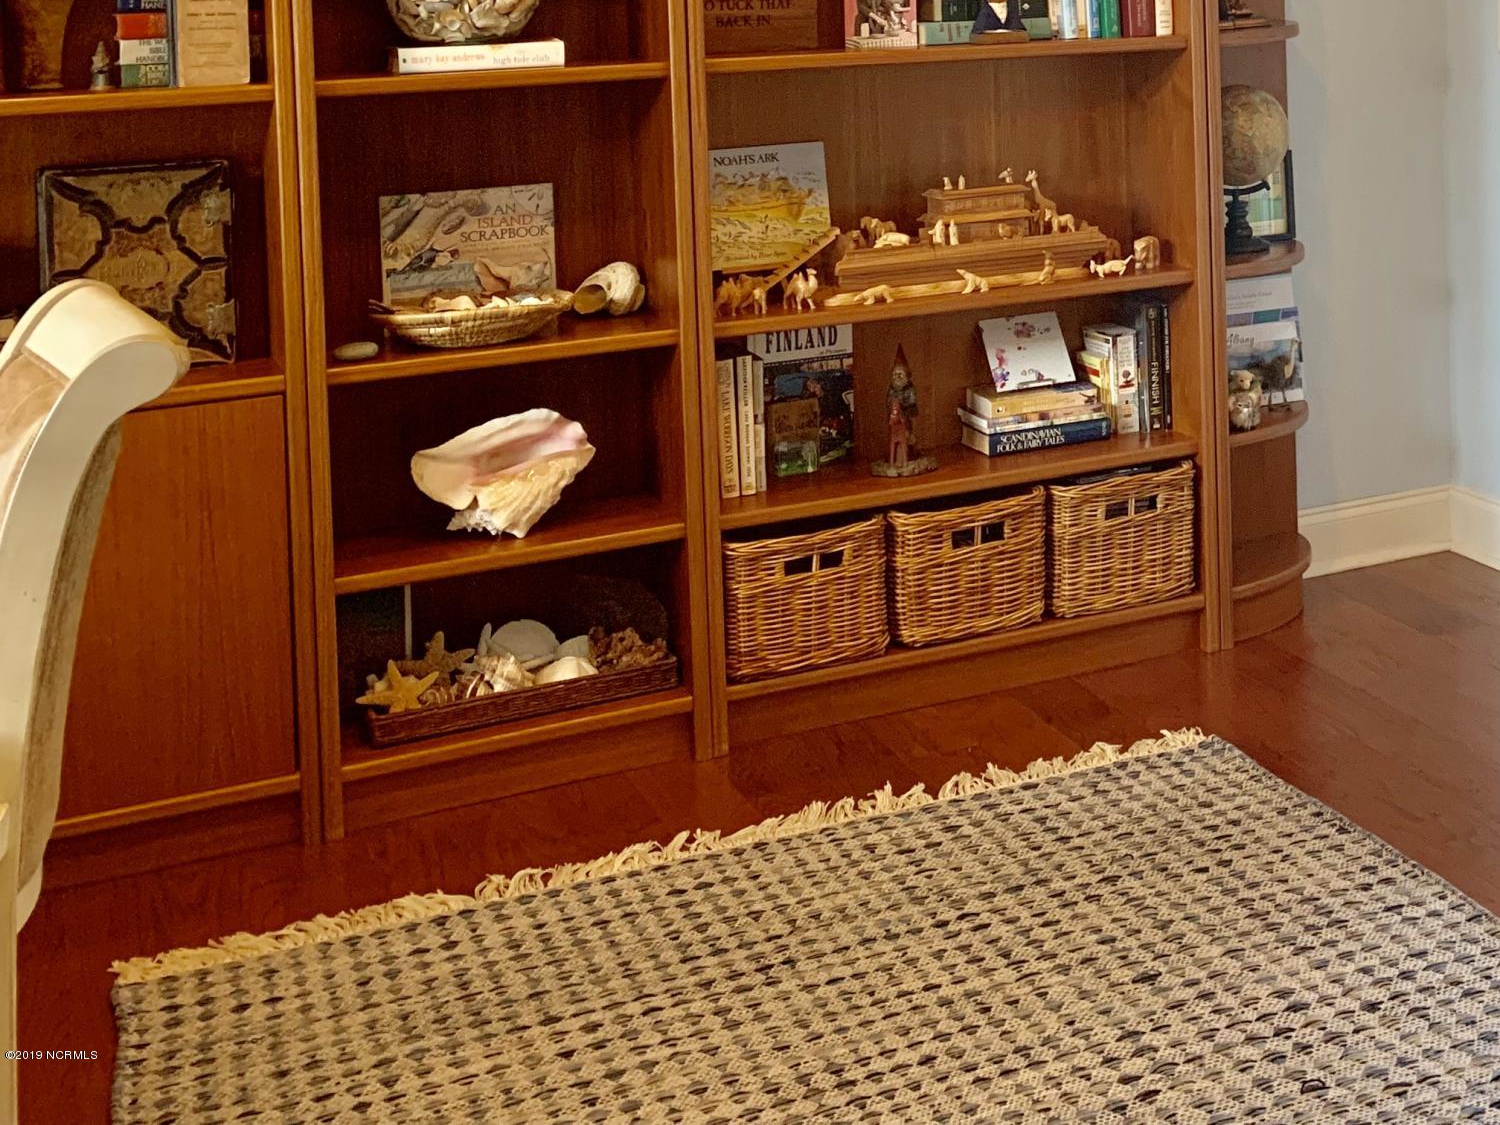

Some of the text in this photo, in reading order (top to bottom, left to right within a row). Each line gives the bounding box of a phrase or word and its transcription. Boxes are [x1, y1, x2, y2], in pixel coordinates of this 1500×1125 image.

[715, 14, 771, 27] BACK IN
[411, 56, 432, 65] mary
[452, 53, 485, 62] andrews
[493, 57, 511, 65] high
[713, 152, 780, 167] NOAH'S ARK
[493, 203, 516, 216] AN
[477, 214, 534, 229] ISLAND
[460, 224, 550, 243] SCRAPBOOK
[765, 325, 838, 354] FINLAND
[1151, 362, 1160, 404] FINNISH
[721, 391, 732, 413] LAKE
[996, 435, 1065, 453] FOLK & FAIRY TALES
[1000, 427, 1062, 444] SCANDINAVIAN
[724, 455, 734, 475] DAYS
